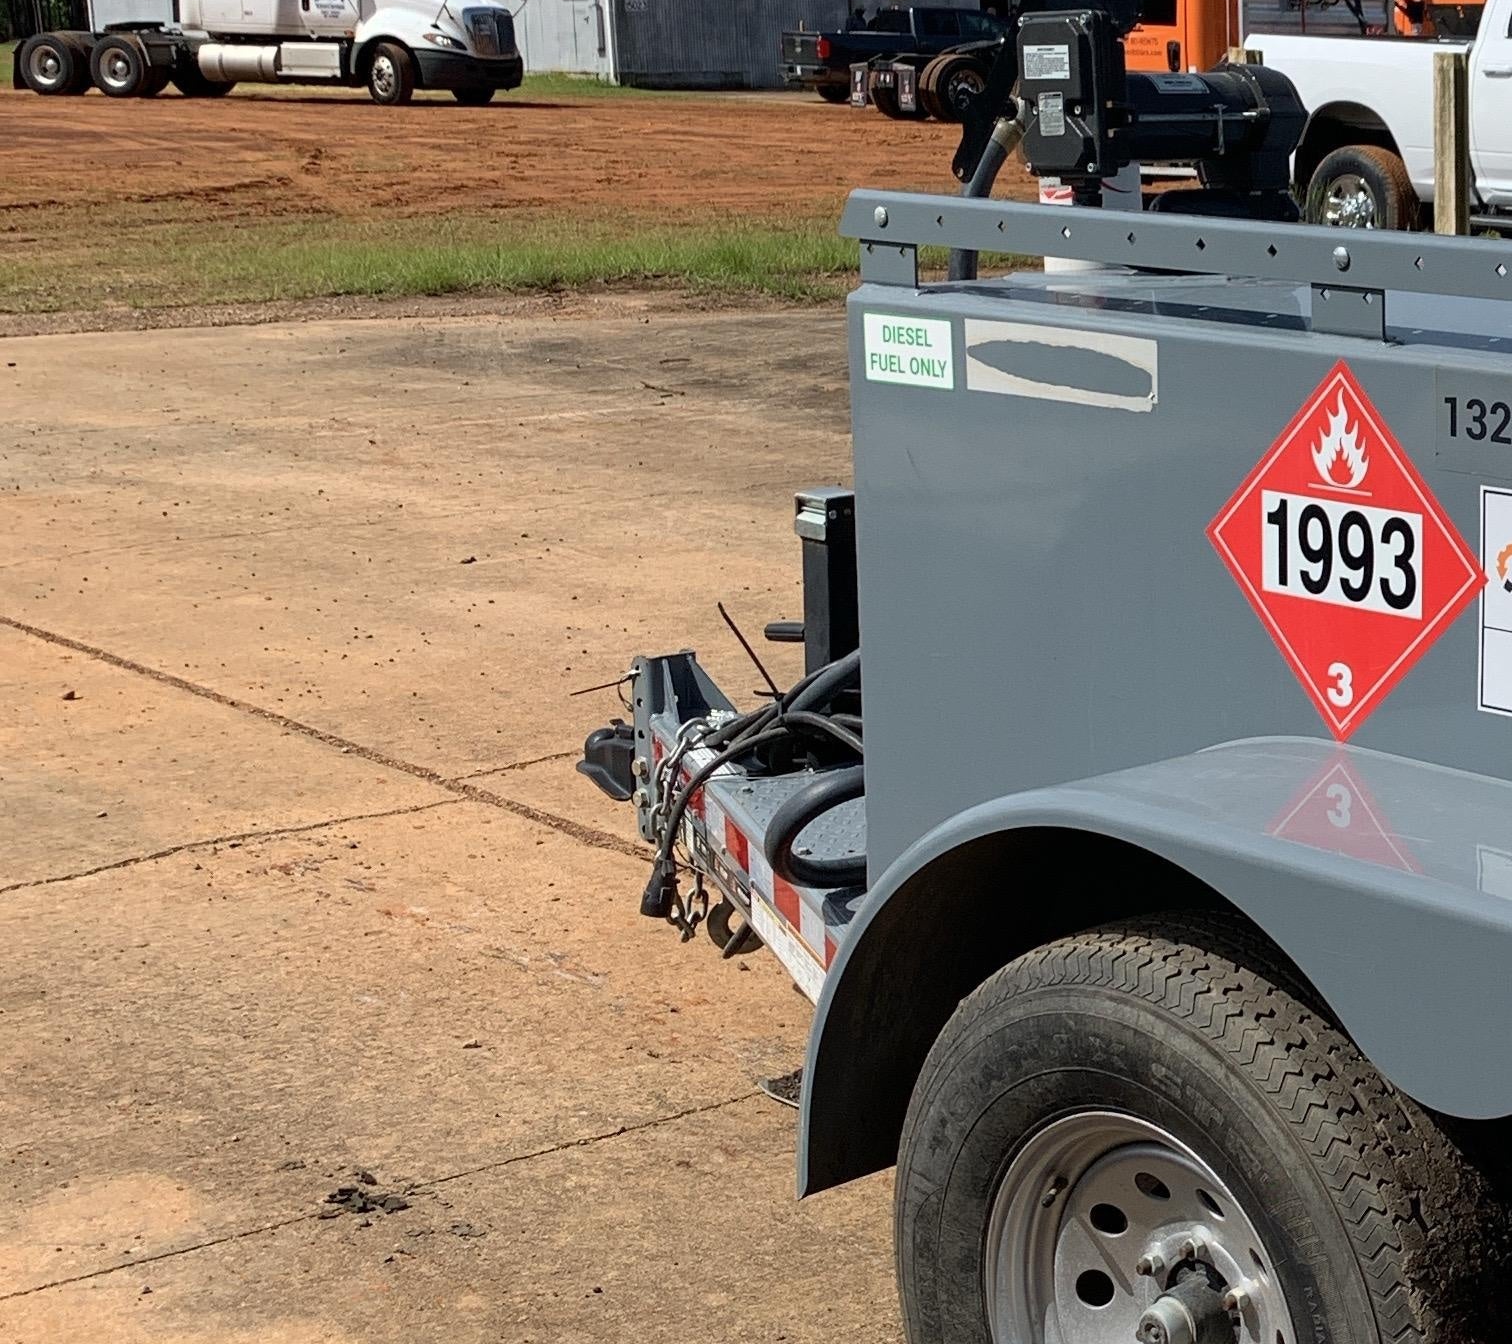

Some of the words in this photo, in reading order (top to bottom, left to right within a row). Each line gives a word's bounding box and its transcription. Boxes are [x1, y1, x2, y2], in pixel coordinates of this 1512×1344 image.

[881, 323, 933, 349] DIESEL
[869, 352, 907, 376] FUEL
[908, 355, 948, 380] ONLY
[1265, 496, 1418, 612] 1993
[1327, 661, 1355, 709] 3
